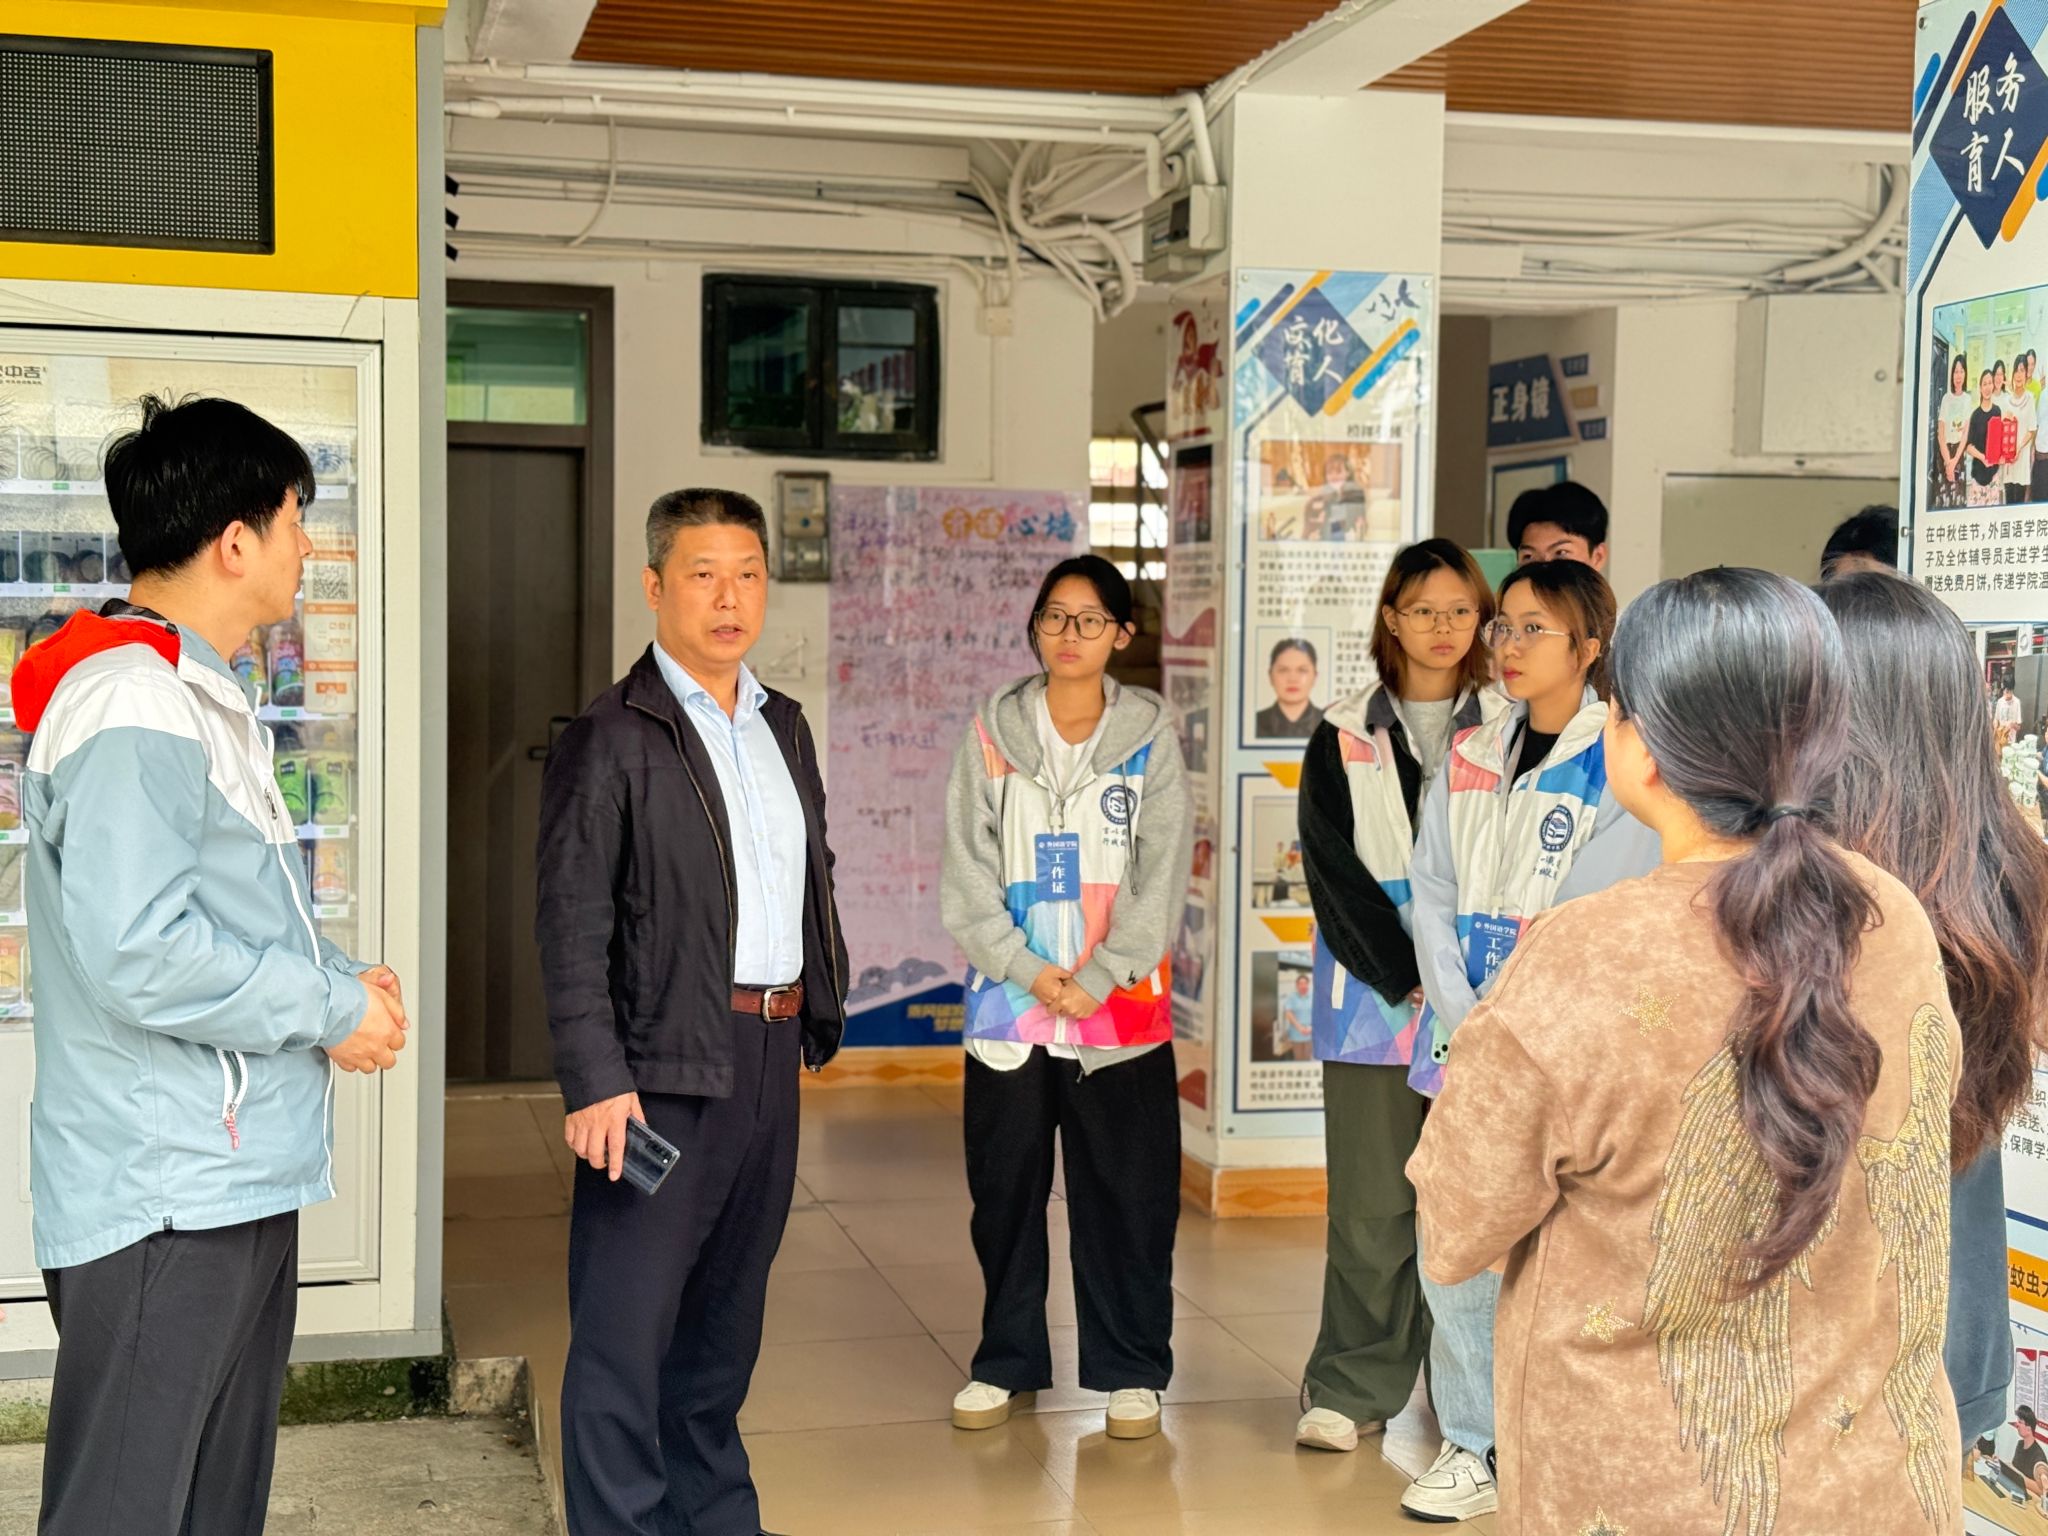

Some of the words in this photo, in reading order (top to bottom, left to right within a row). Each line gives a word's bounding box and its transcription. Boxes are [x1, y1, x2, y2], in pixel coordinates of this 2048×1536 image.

[1963, 52, 2026, 125] 服务
[1960, 127, 2025, 192] 育人
[1284, 352, 1343, 385] 育人
[1050, 852, 1066, 893] 工作证
[2004, 1134, 2048, 1161] ，保障学
[2009, 1264, 2048, 1298] 蚊虫
